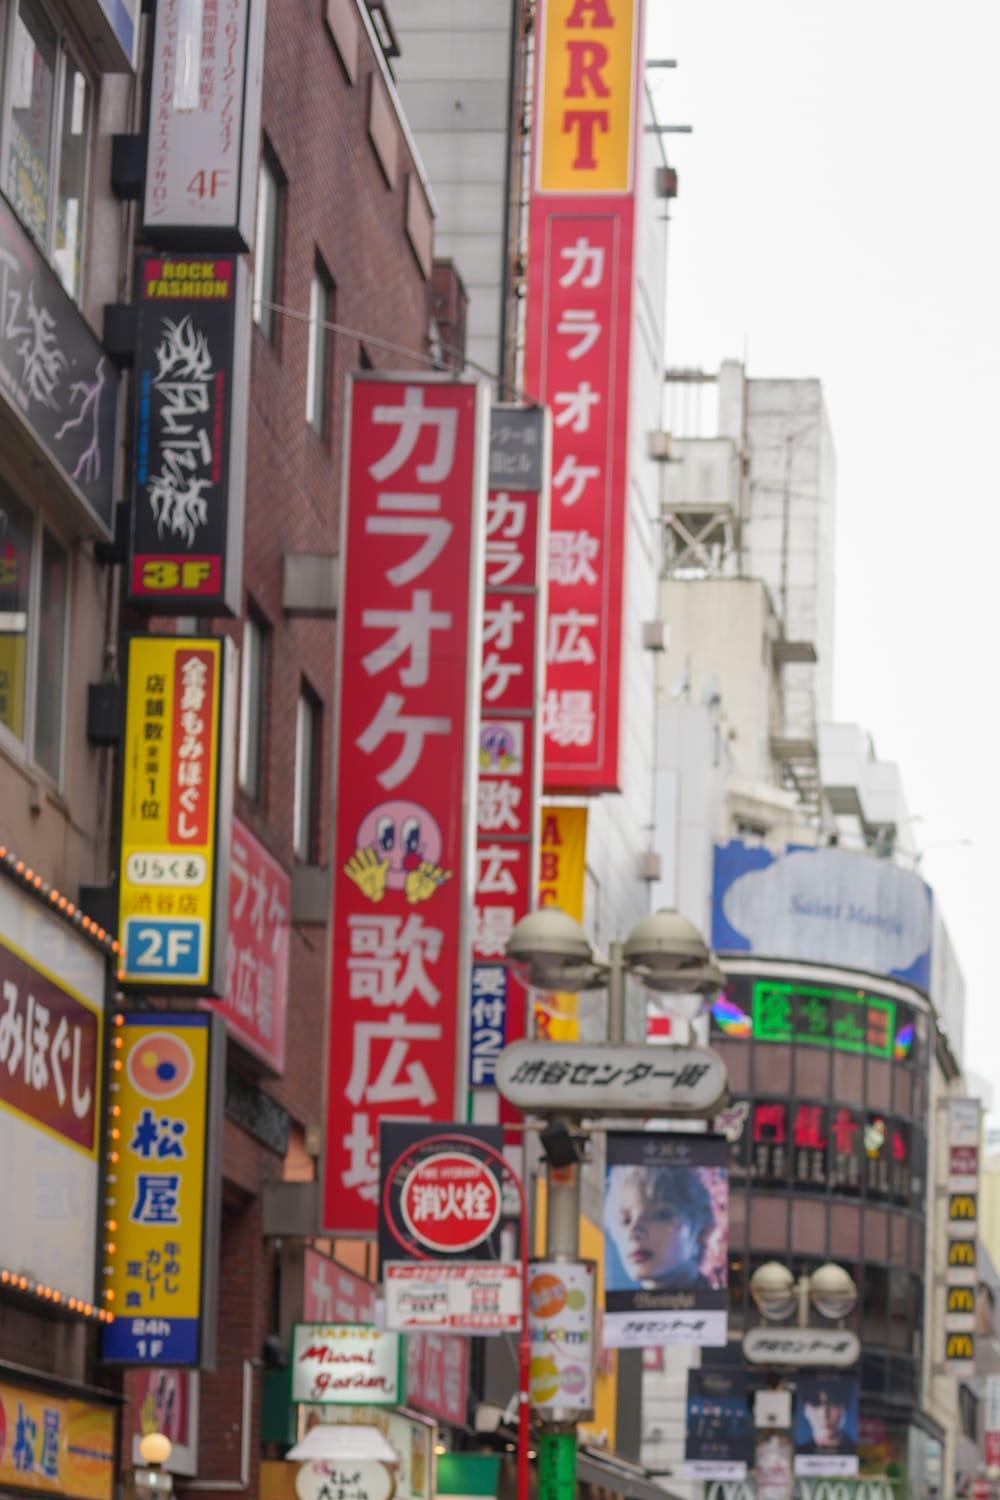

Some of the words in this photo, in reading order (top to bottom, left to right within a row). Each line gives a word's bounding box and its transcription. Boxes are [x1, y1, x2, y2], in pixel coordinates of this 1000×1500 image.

[187, 169, 231, 198] 4F
[148, 280, 228, 298] FASHION
[163, 262, 215, 280] ROCK
[542, 237, 605, 747] カラオケ歌広場
[142, 561, 211, 590] 3F
[355, 386, 459, 791] カラオケ
[482, 493, 527, 702] カラオケ
[177, 656, 208, 840] 全身もみほぐし
[132, 858, 199, 880] りらくる
[136, 928, 194, 968] 2F
[509, 1059, 713, 1089] 渋谷センター街
[130, 1109, 186, 1226] 松屋
[412, 1182, 492, 1222] 消火栓
[125, 1260, 142, 1308] 定食
[146, 1248, 161, 1302] カレー
[163, 1242, 181, 1294] 牛めし
[131, 1318, 171, 1337] 24h
[136, 1340, 163, 1358] 1F
[299, 1346, 377, 1365] Miami
